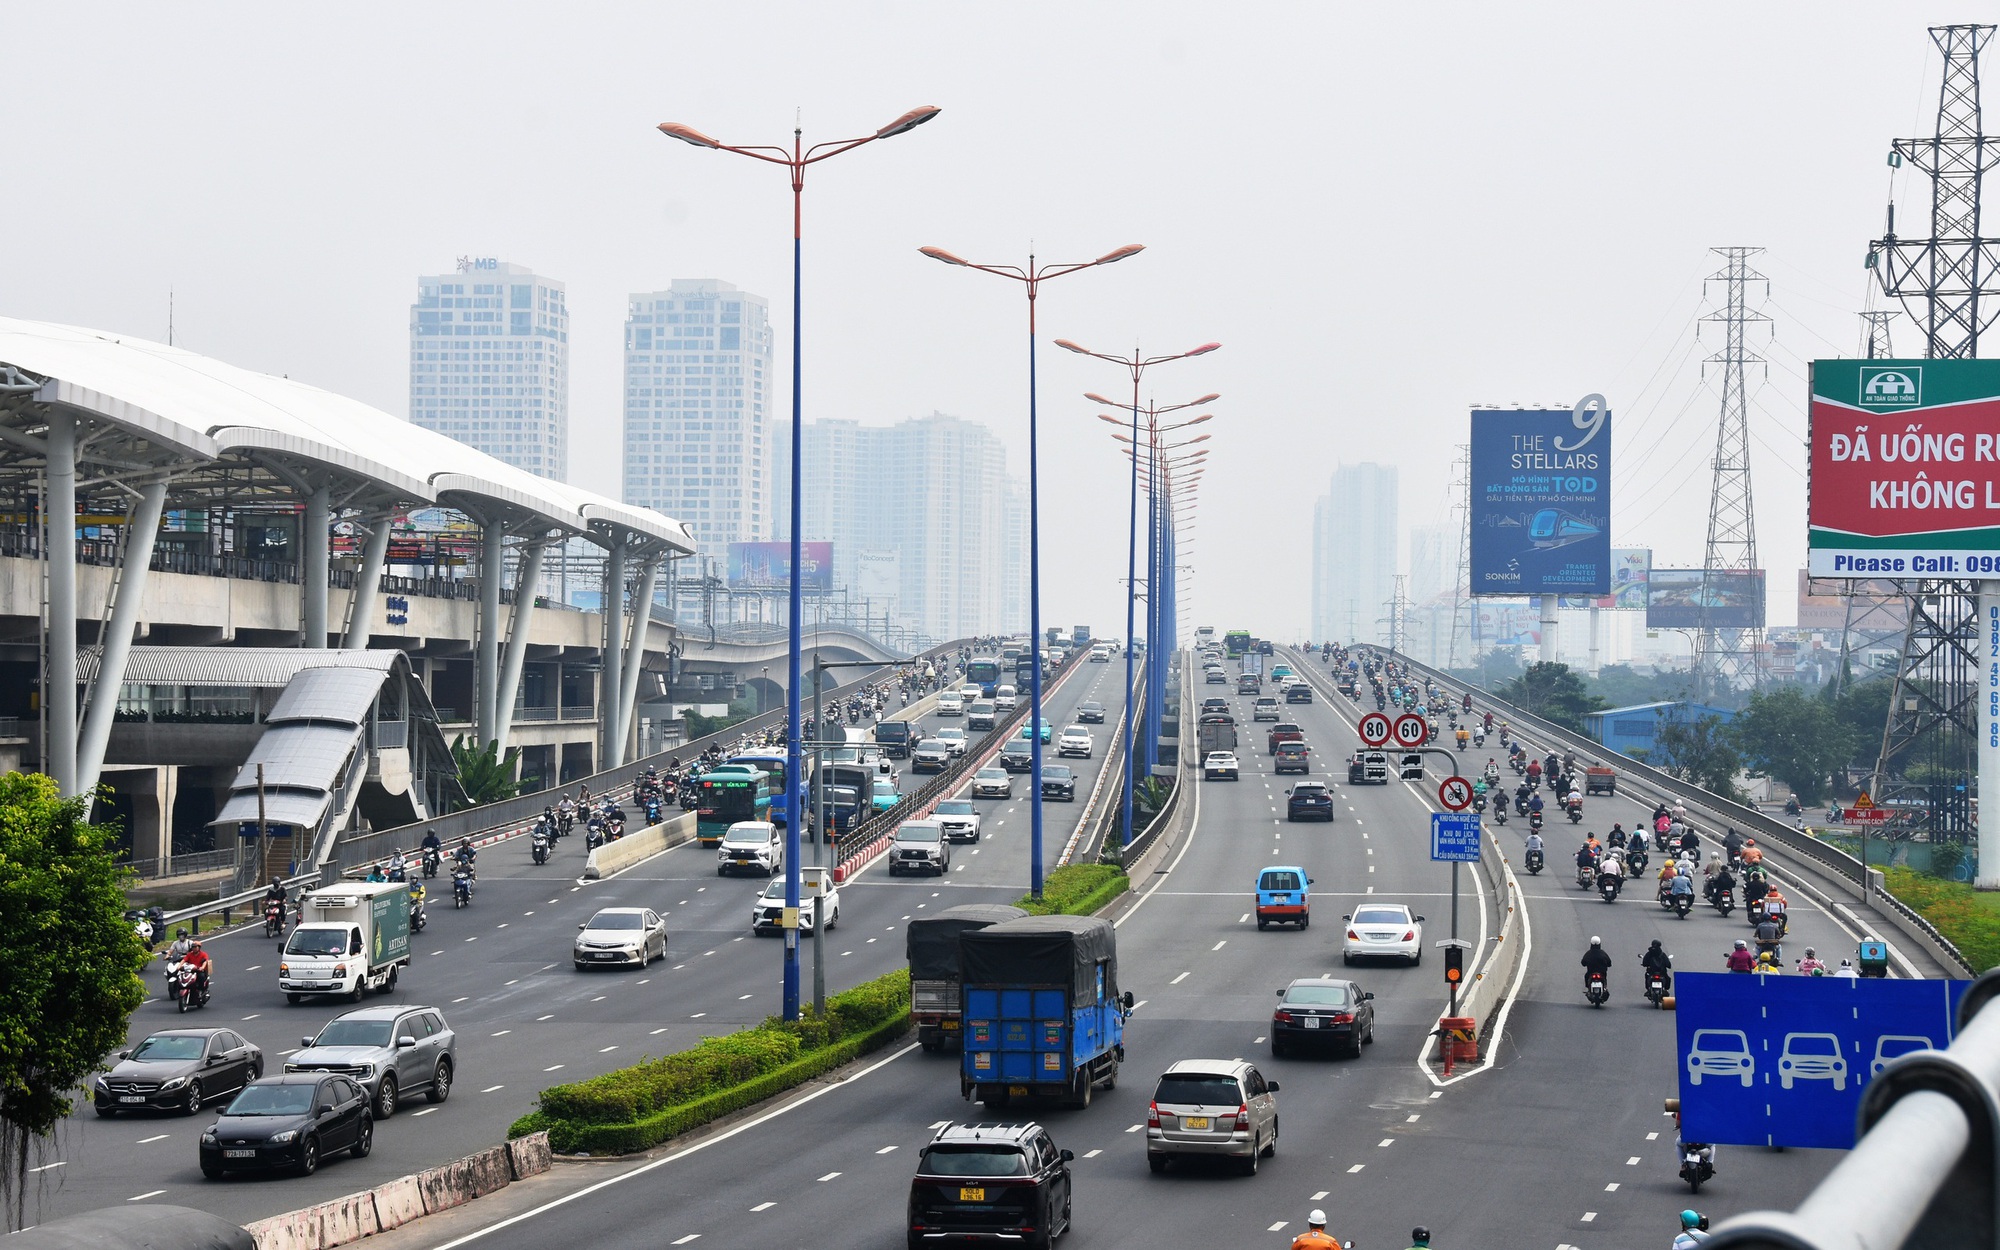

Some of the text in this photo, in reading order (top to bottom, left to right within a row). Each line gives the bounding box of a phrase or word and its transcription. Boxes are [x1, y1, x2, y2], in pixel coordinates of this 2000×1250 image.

[475, 258, 497, 270] MB
[1511, 393, 1607, 452] THE 9
[1830, 423, 2000, 463] ĐÃ UỐNG R
[1511, 453, 1599, 470] STELLARS
[1552, 476, 1598, 493] TOD
[1870, 471, 1975, 509] KHÔNG
[1624, 554, 1643, 564] Vikki
[1834, 555, 1905, 572] Please
[1912, 555, 1959, 573] Call:
[1366, 722, 1384, 737] 80
[1401, 722, 1419, 738] 60
